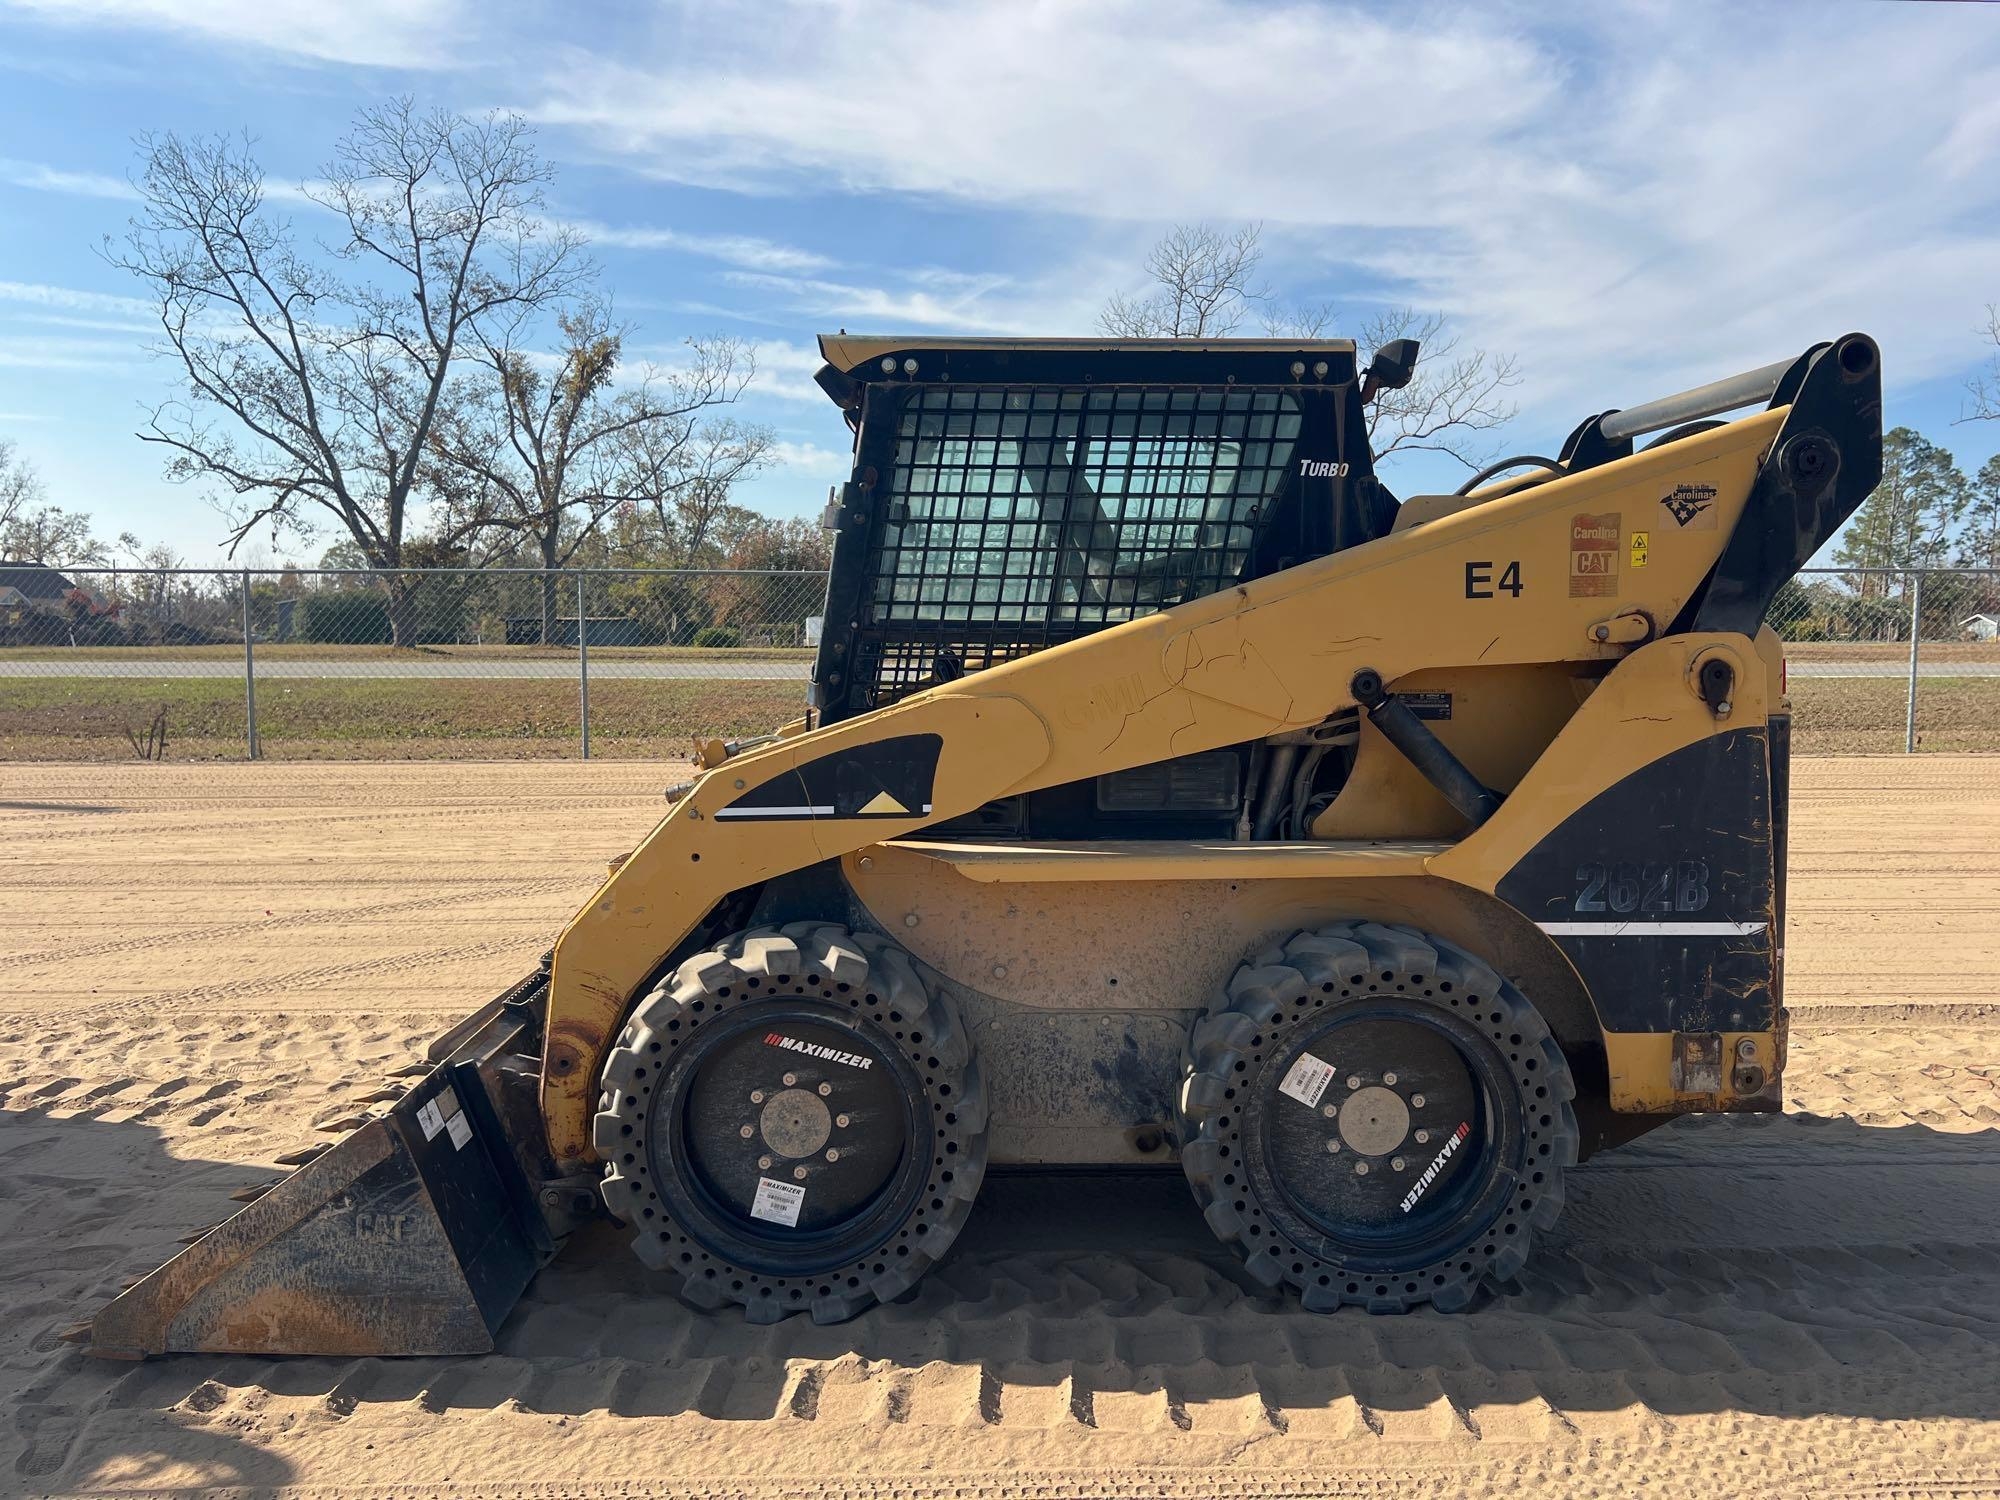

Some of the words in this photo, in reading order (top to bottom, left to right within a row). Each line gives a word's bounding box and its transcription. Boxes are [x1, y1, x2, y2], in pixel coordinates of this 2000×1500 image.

[1671, 490, 1714, 500] Carolinas
[1573, 526, 1617, 539] Carolina
[1577, 552, 1612, 574] CAT
[1465, 561, 1524, 599] E4
[1574, 860, 1709, 913] 262B
[779, 1037, 873, 1069] MAXIMIZER
[1309, 1071, 1330, 1104] MAXIMIZER
[1400, 1133, 1462, 1213] MAXIMIZER
[767, 1182, 801, 1195] MAXIMIZER
[355, 1213, 406, 1242] CAT
